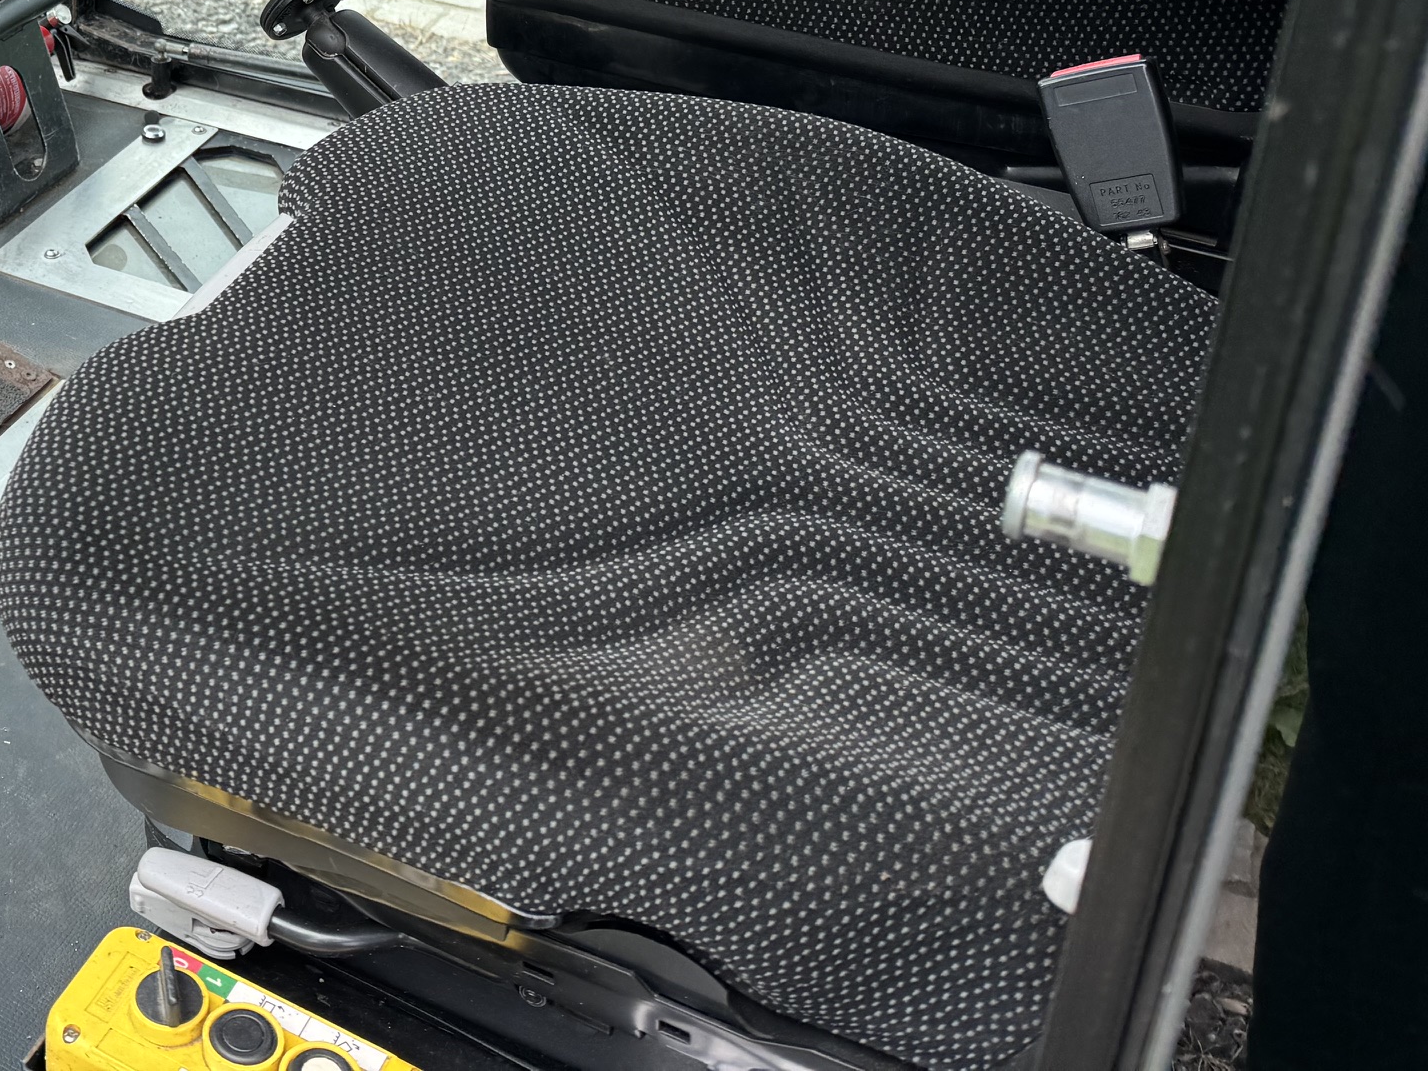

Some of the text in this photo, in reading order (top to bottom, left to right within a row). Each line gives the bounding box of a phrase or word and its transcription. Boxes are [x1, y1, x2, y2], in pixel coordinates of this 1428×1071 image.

[1100, 182, 1150, 197] PART No
[205, 976, 222, 987] 1
